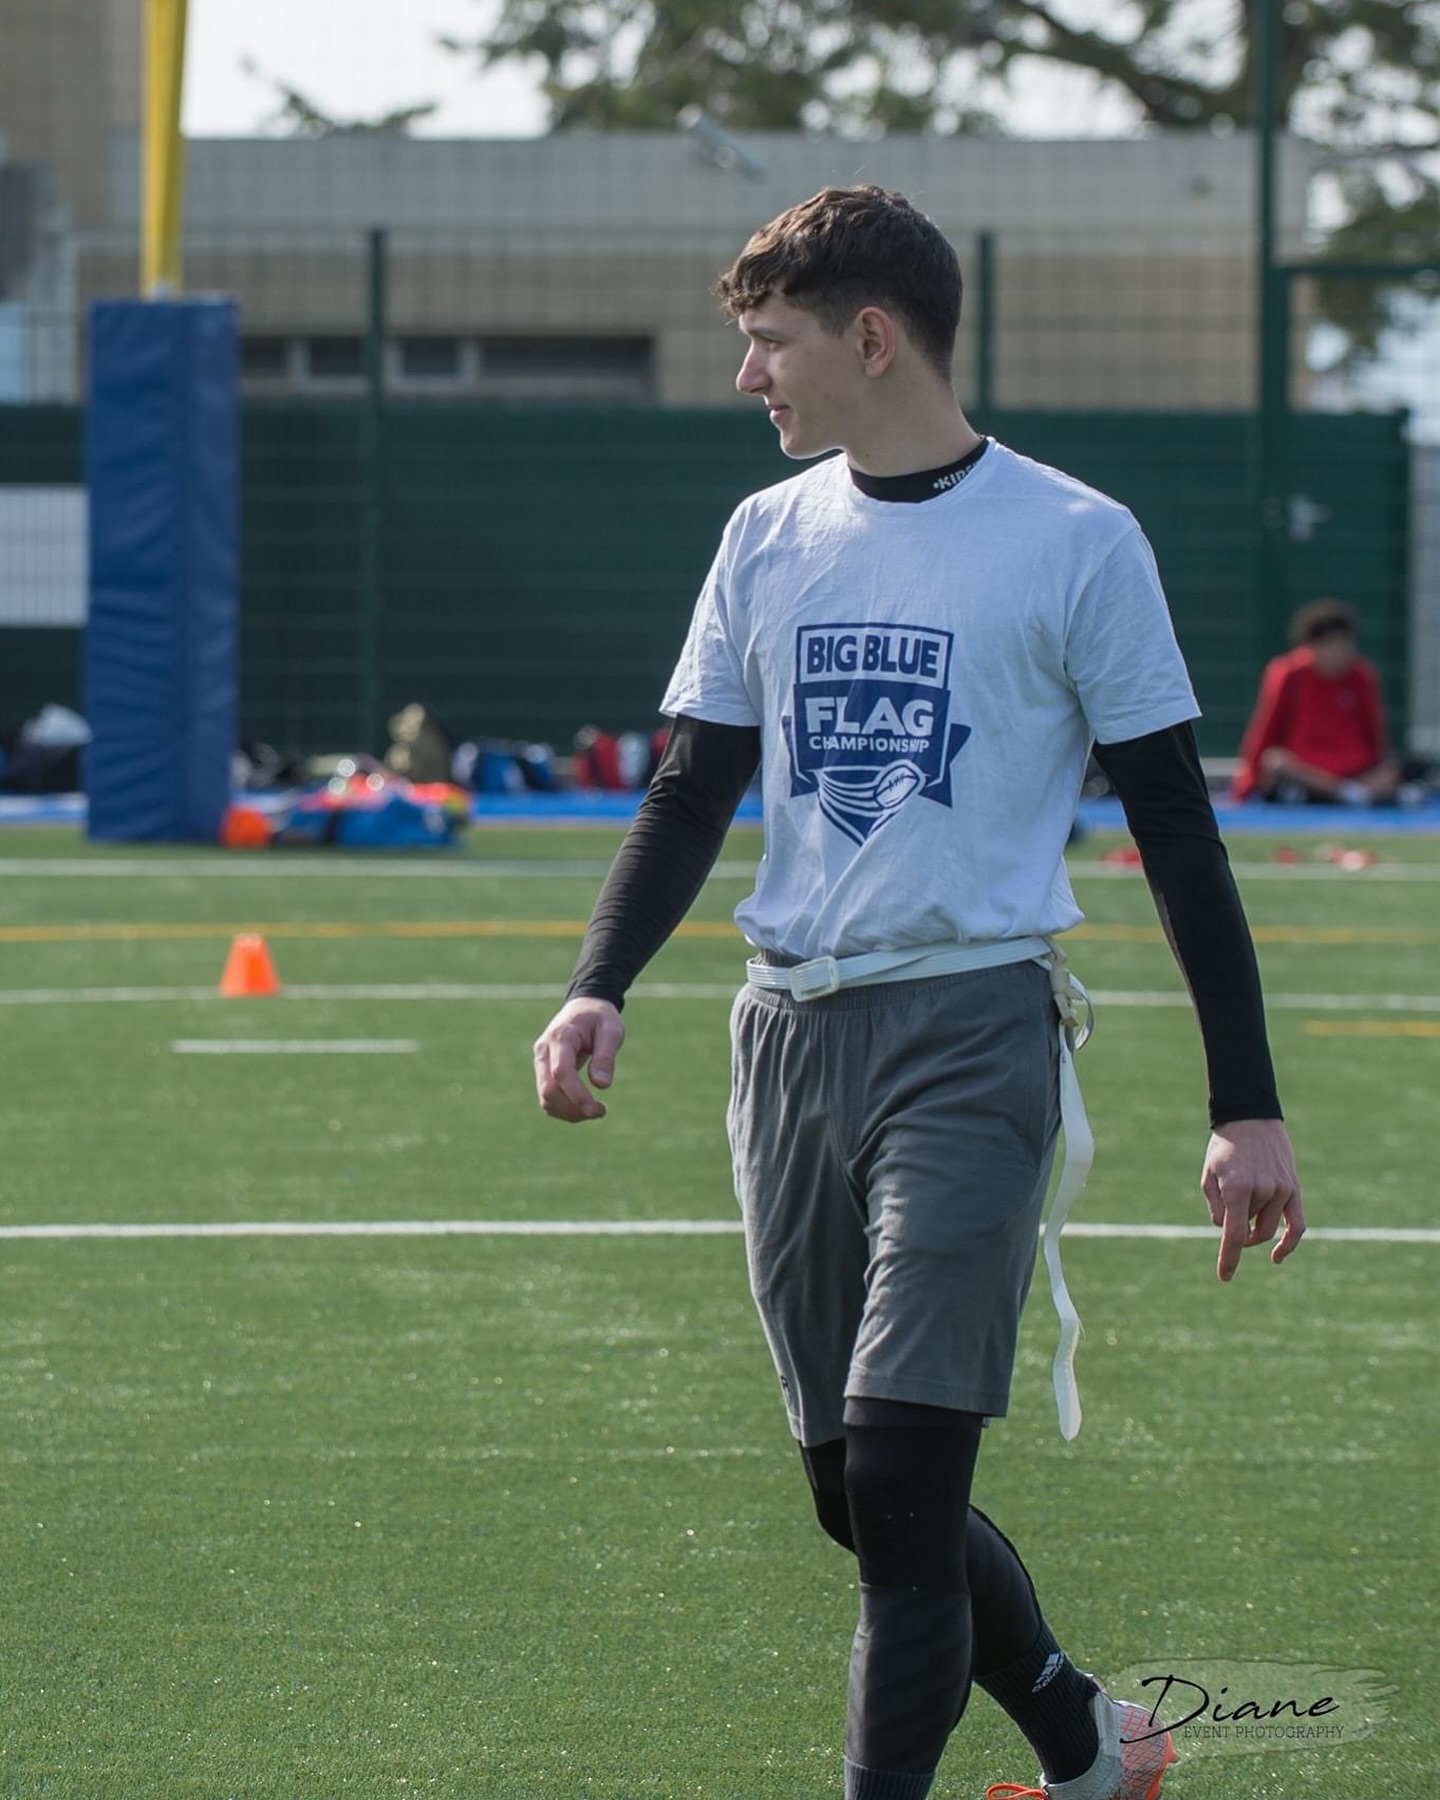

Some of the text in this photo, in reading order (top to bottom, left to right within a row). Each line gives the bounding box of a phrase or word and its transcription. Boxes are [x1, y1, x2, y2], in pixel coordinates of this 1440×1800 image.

[937, 462, 975, 489] KIP
[806, 634, 941, 679] BIG BLUE
[805, 697, 934, 737] FLAG
[808, 735, 931, 754] CHAMPIONSHIP
